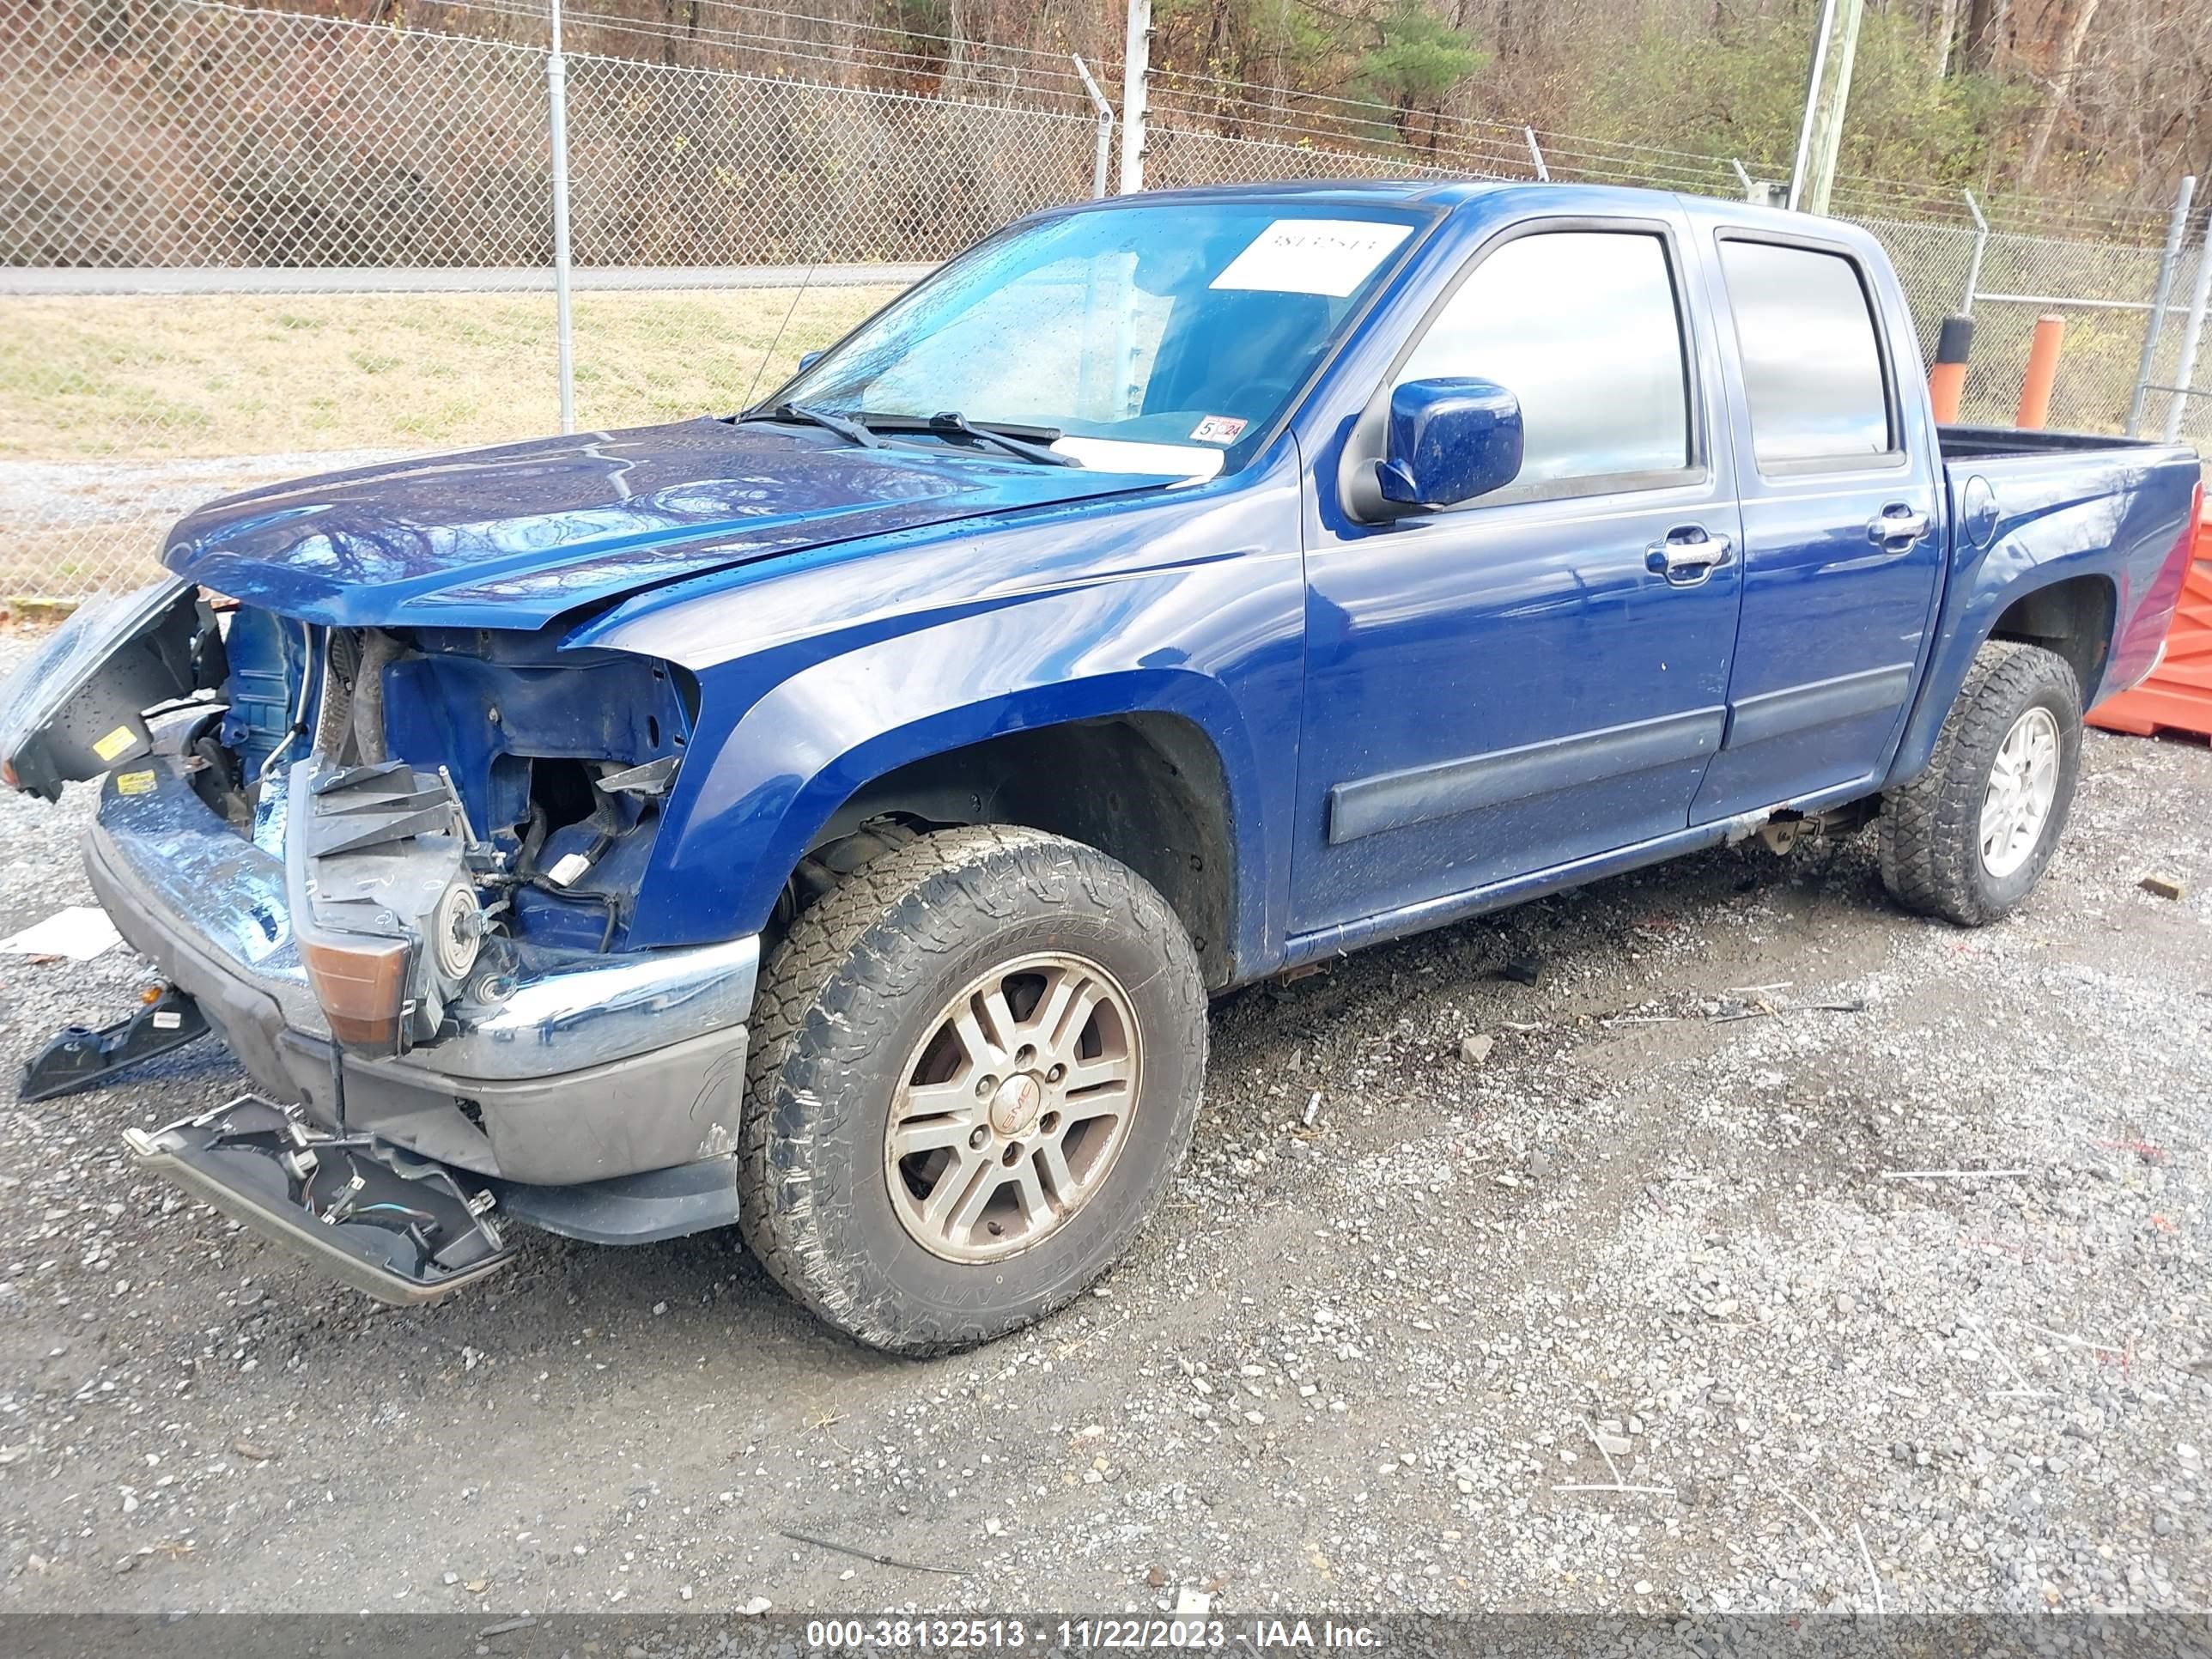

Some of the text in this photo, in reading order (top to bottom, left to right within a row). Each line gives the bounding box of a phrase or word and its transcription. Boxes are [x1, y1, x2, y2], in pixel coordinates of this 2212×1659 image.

[1200, 422, 1216, 435] 5
[917, 919, 1120, 1017] THUNDERER
[1002, 1082, 1032, 1129] GMC
